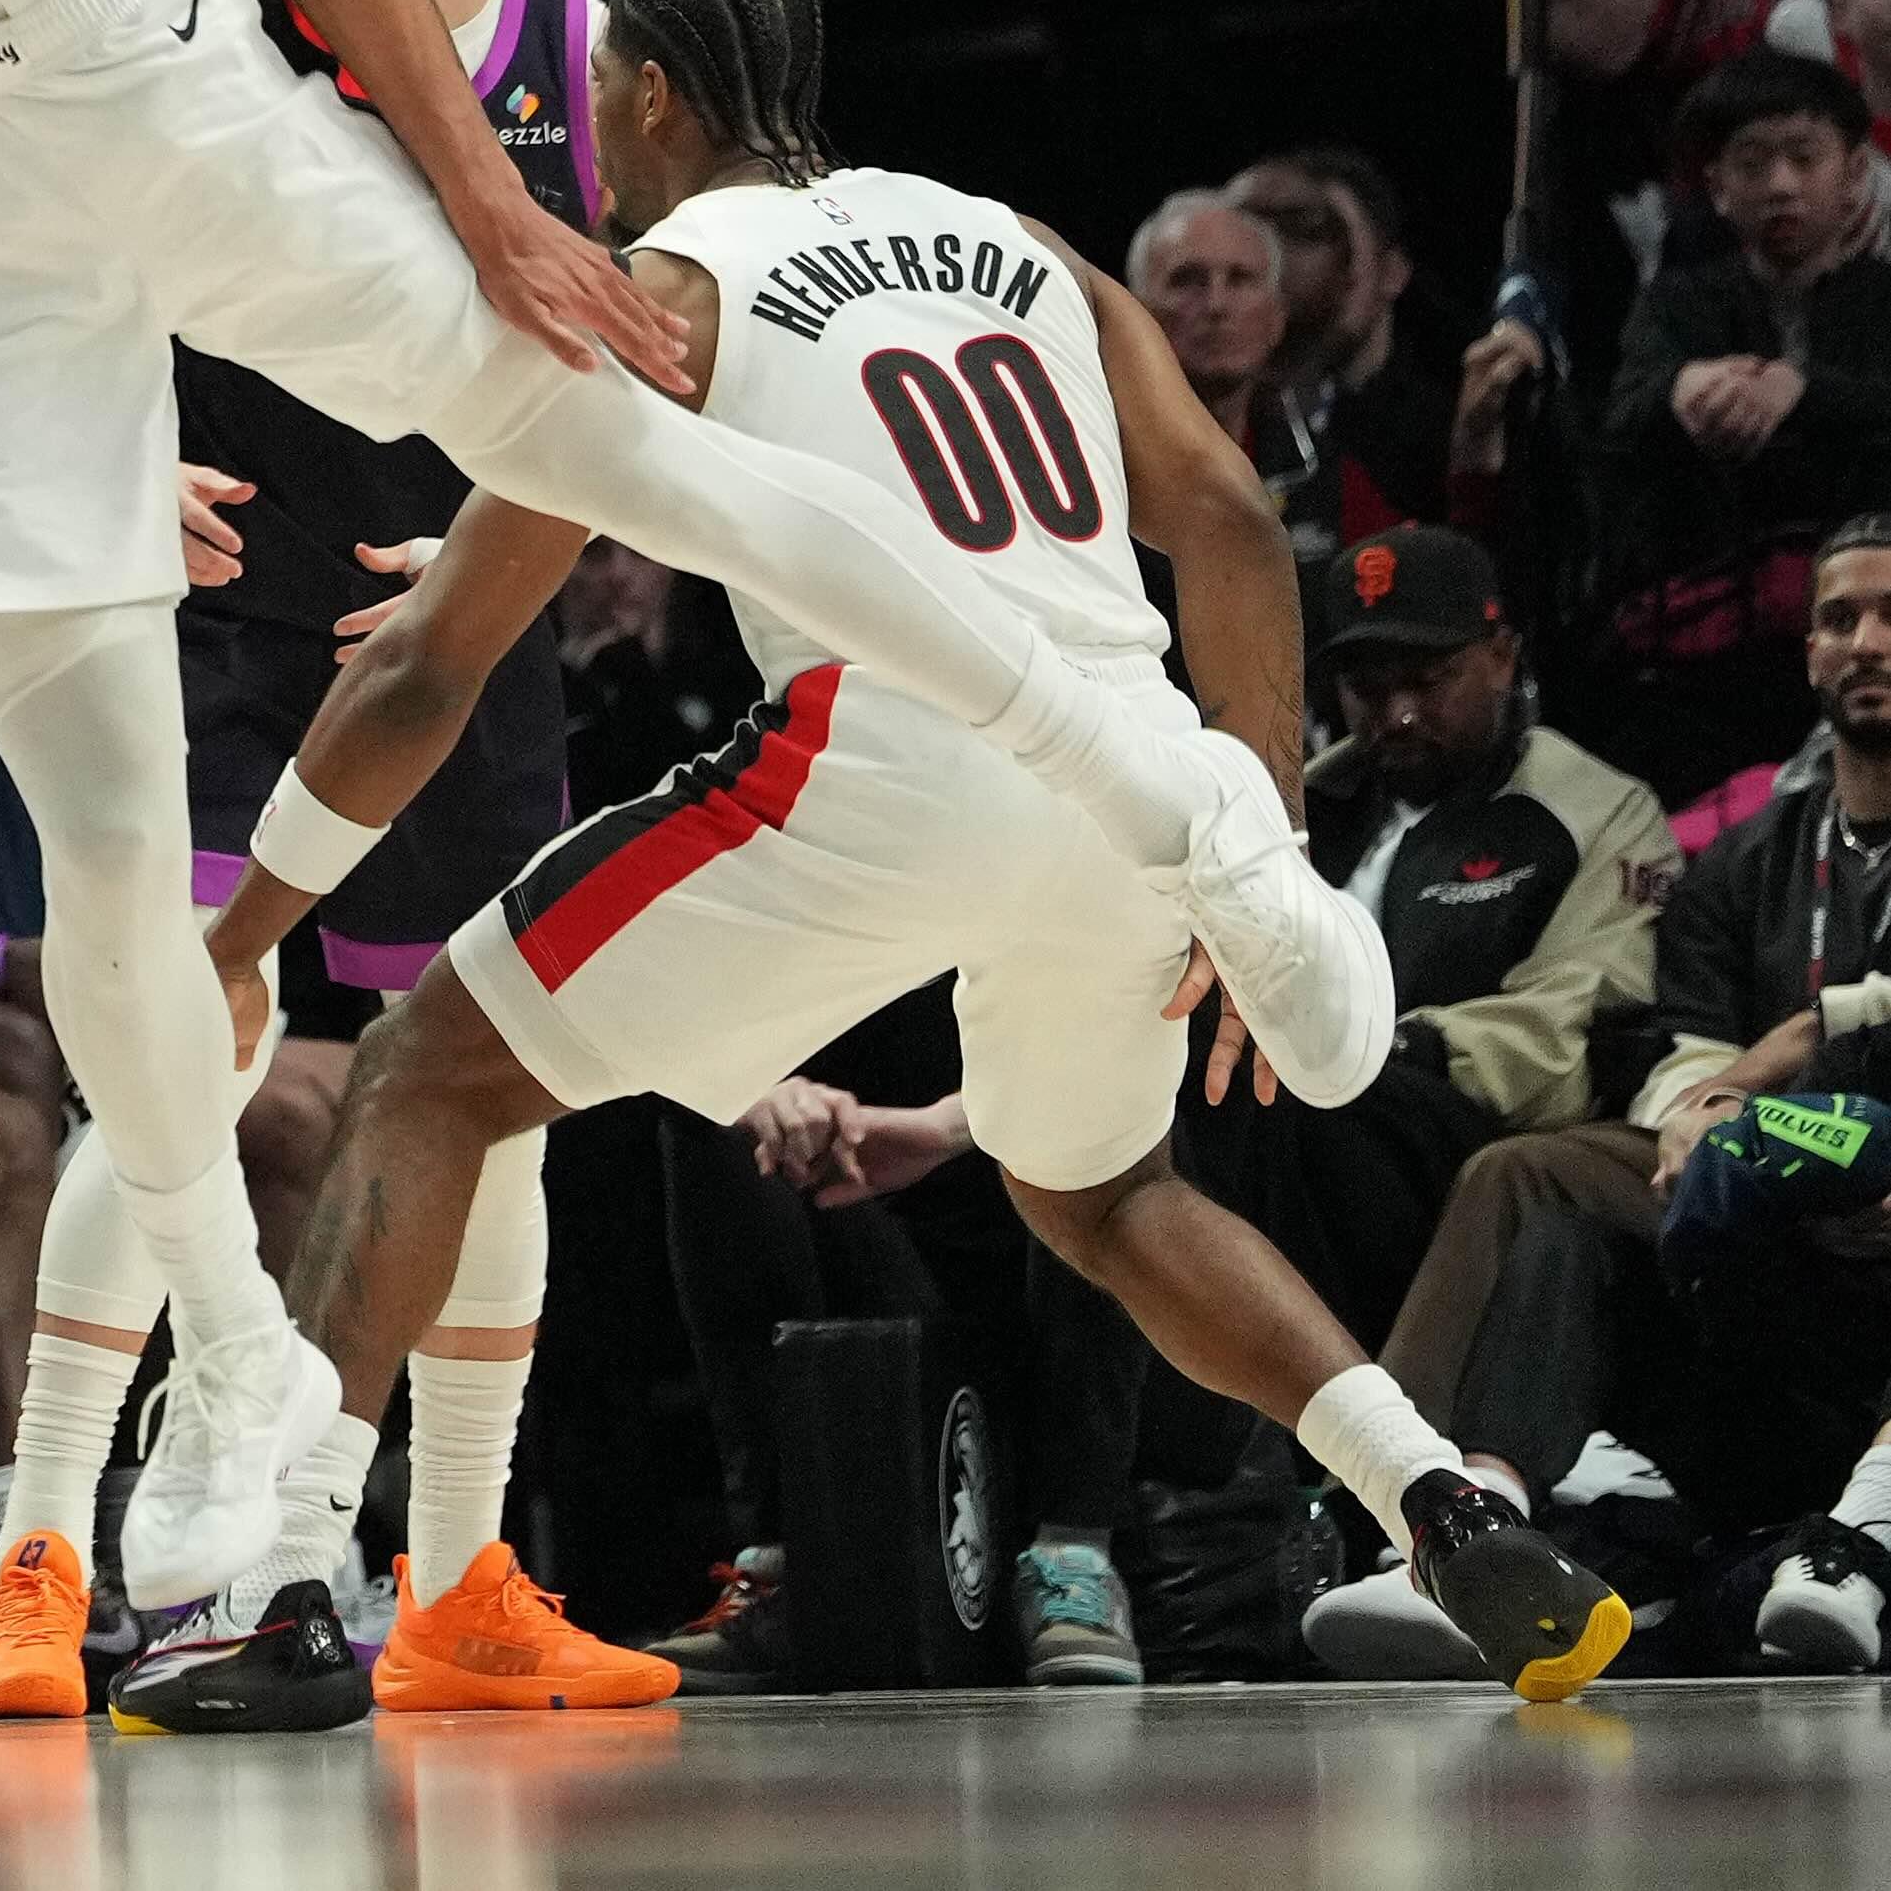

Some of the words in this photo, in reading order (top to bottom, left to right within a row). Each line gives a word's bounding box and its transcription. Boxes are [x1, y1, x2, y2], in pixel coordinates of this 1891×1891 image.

[493, 121, 567, 146] ezzle
[749, 233, 1048, 344] HENDERSON
[861, 333, 1103, 553] 00
